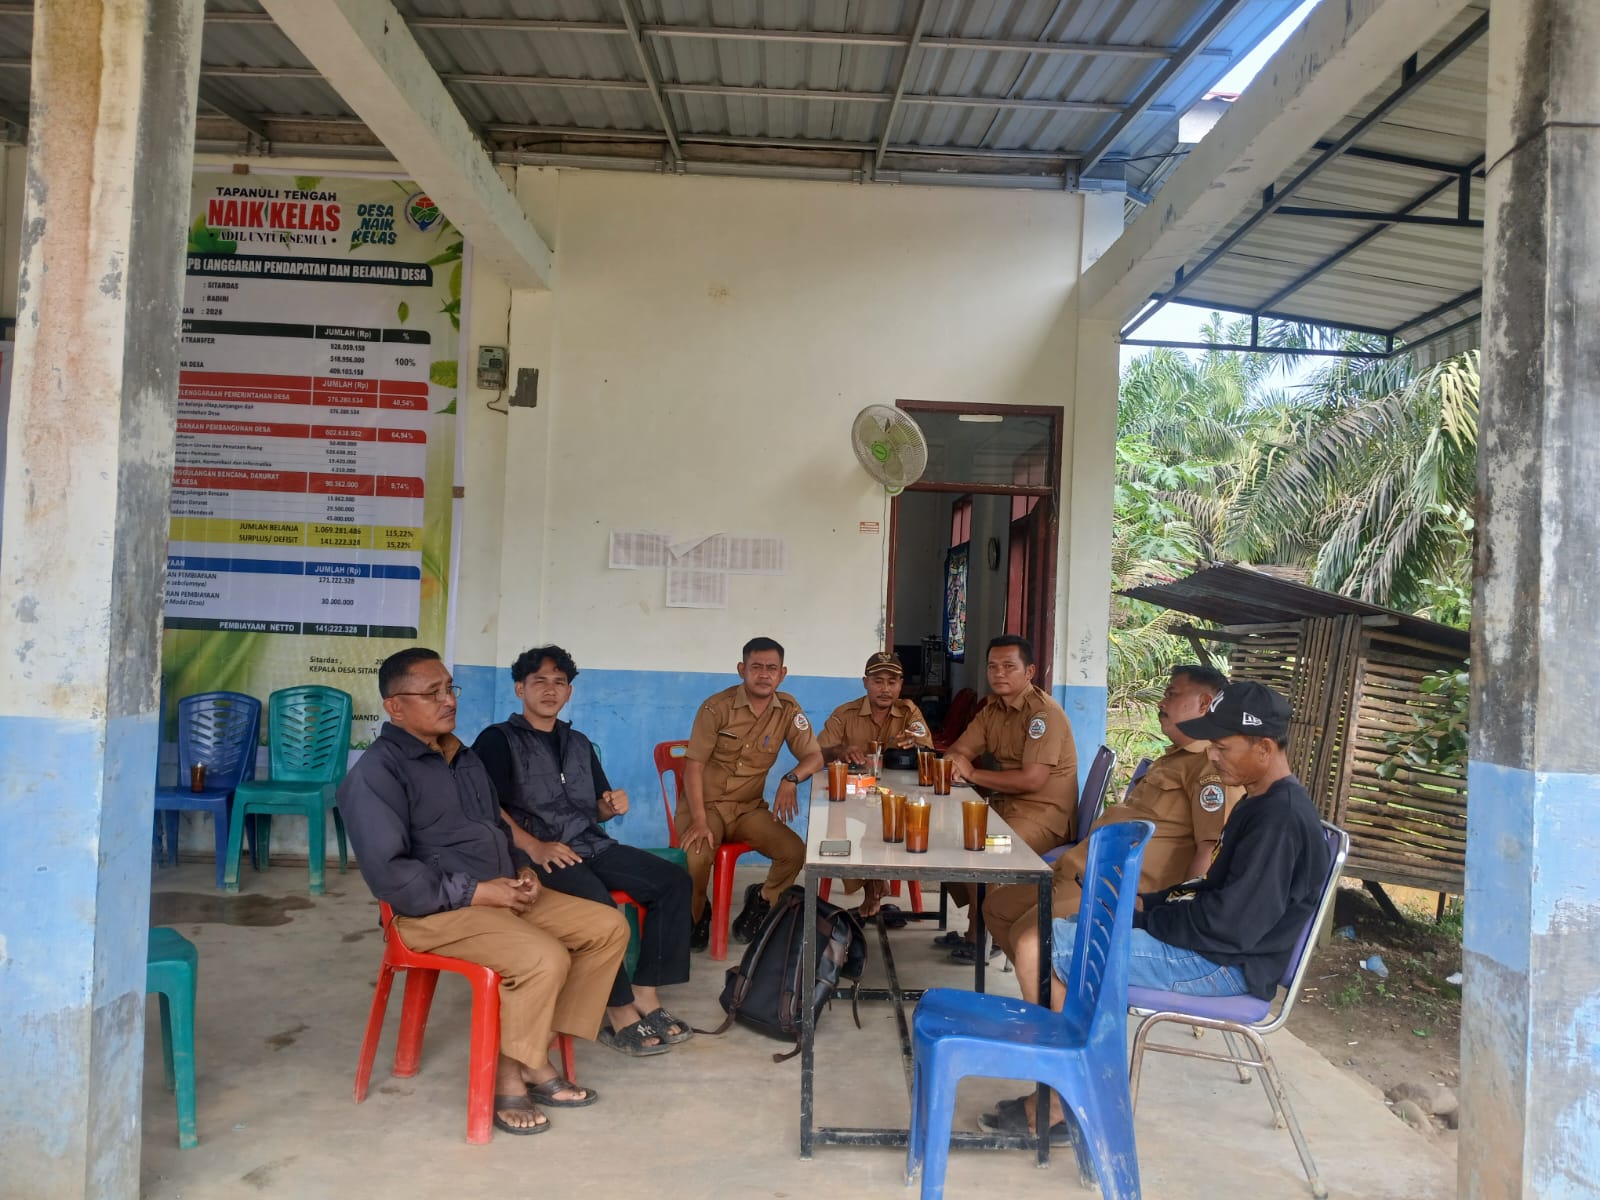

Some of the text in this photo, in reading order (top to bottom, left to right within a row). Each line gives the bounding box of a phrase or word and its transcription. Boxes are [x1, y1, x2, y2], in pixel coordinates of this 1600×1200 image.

[216, 187, 337, 201] TAPANULI TENGAH
[208, 199, 341, 231] NAIK KELAS
[357, 203, 394, 217] DESA
[361, 217, 395, 230] NAIK
[221, 231, 327, 245] ADIL UNTUK SEMUA
[351, 231, 397, 245] KELAS
[187, 258, 201, 270] PB
[264, 261, 327, 276] PENDAPATAN
[329, 264, 350, 277] DAN
[402, 267, 427, 281] DESA
[325, 328, 372, 340] JUMLAH (Rp)
[395, 357, 417, 367] 100%
[323, 380, 353, 389] JUMLAH
[239, 522, 299, 532] JUMLAH BELANJA
[315, 565, 362, 575] JUMLAH (Rp)
[219, 621, 295, 632] PEMBIAYAAN NETTO
[309, 666, 379, 676] KEPALA DESA SITAR
[352, 714, 379, 722] WANTO
